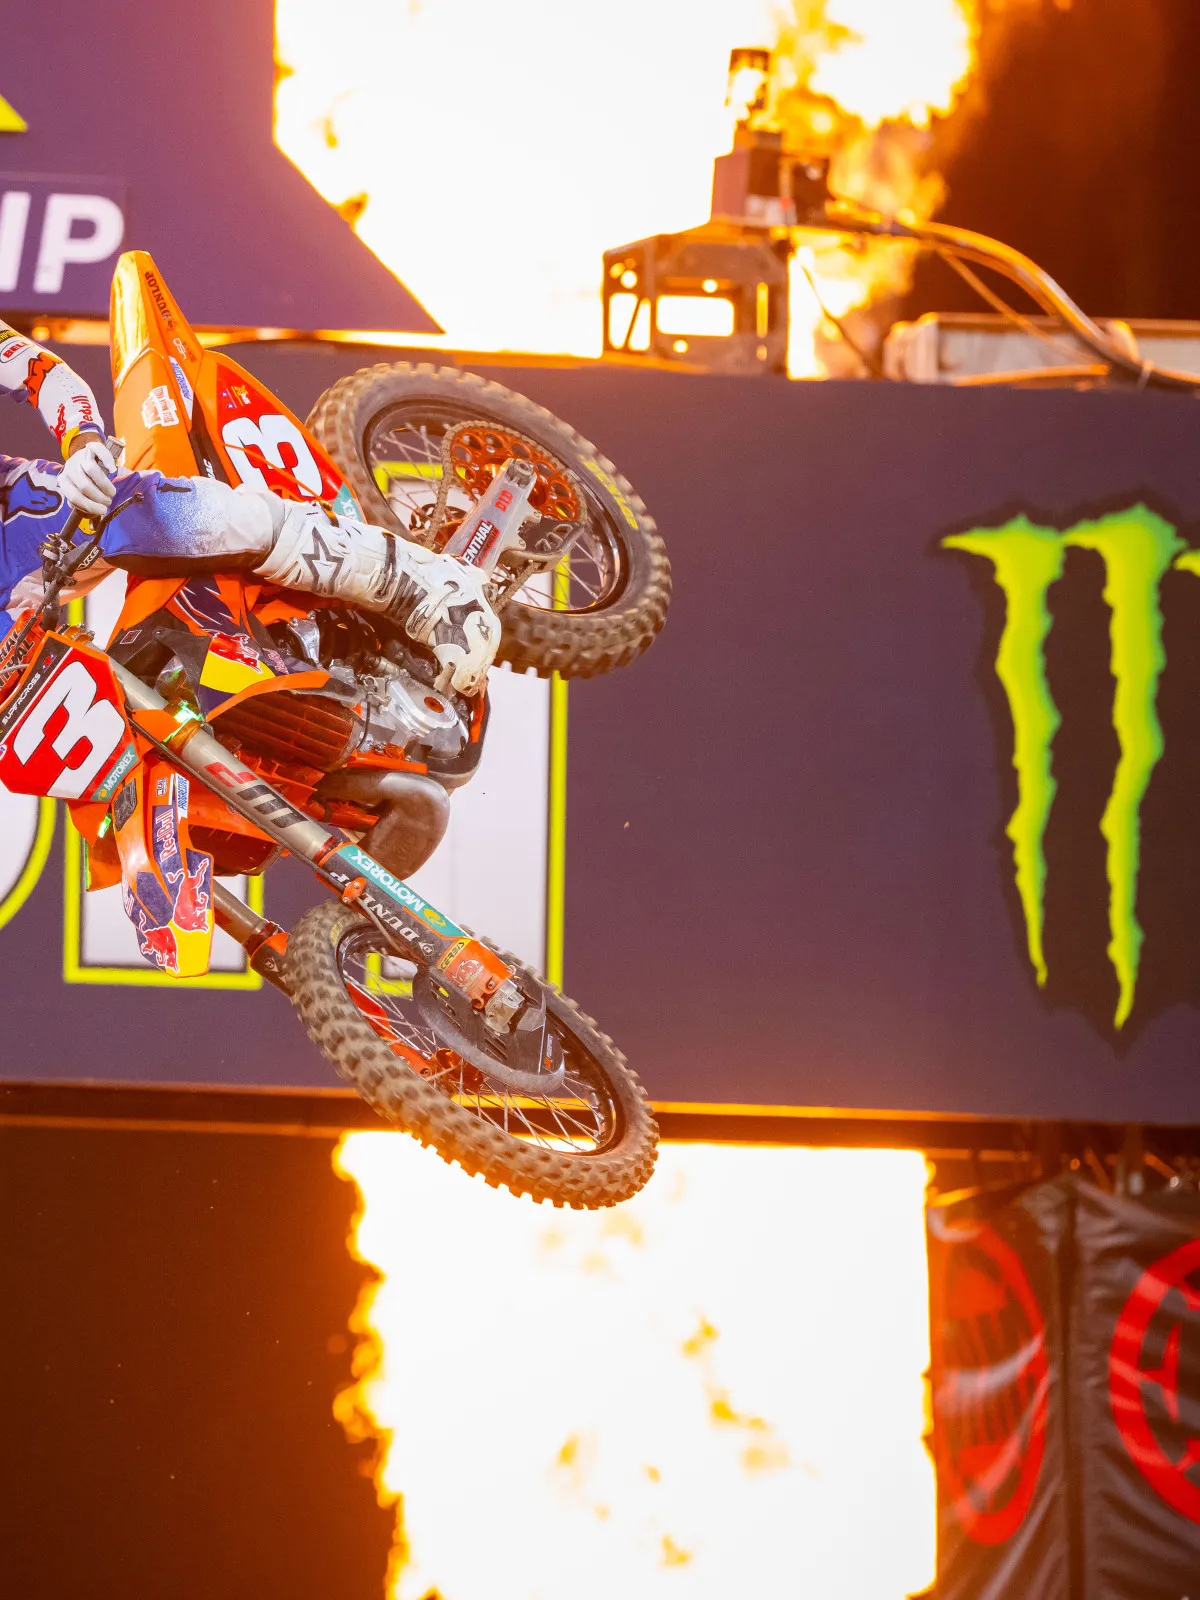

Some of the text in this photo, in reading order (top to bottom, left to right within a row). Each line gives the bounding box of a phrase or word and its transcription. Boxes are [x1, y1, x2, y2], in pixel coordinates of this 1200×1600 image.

[221, 414, 323, 497] 3
[460, 521, 493, 565] ENTHAL
[1, 672, 40, 725] SUPERCROSS
[12, 660, 126, 800] 3
[105, 752, 136, 791] MOTOREX
[330, 871, 420, 942] DUNLP
[351, 850, 425, 912] MOTOREX
